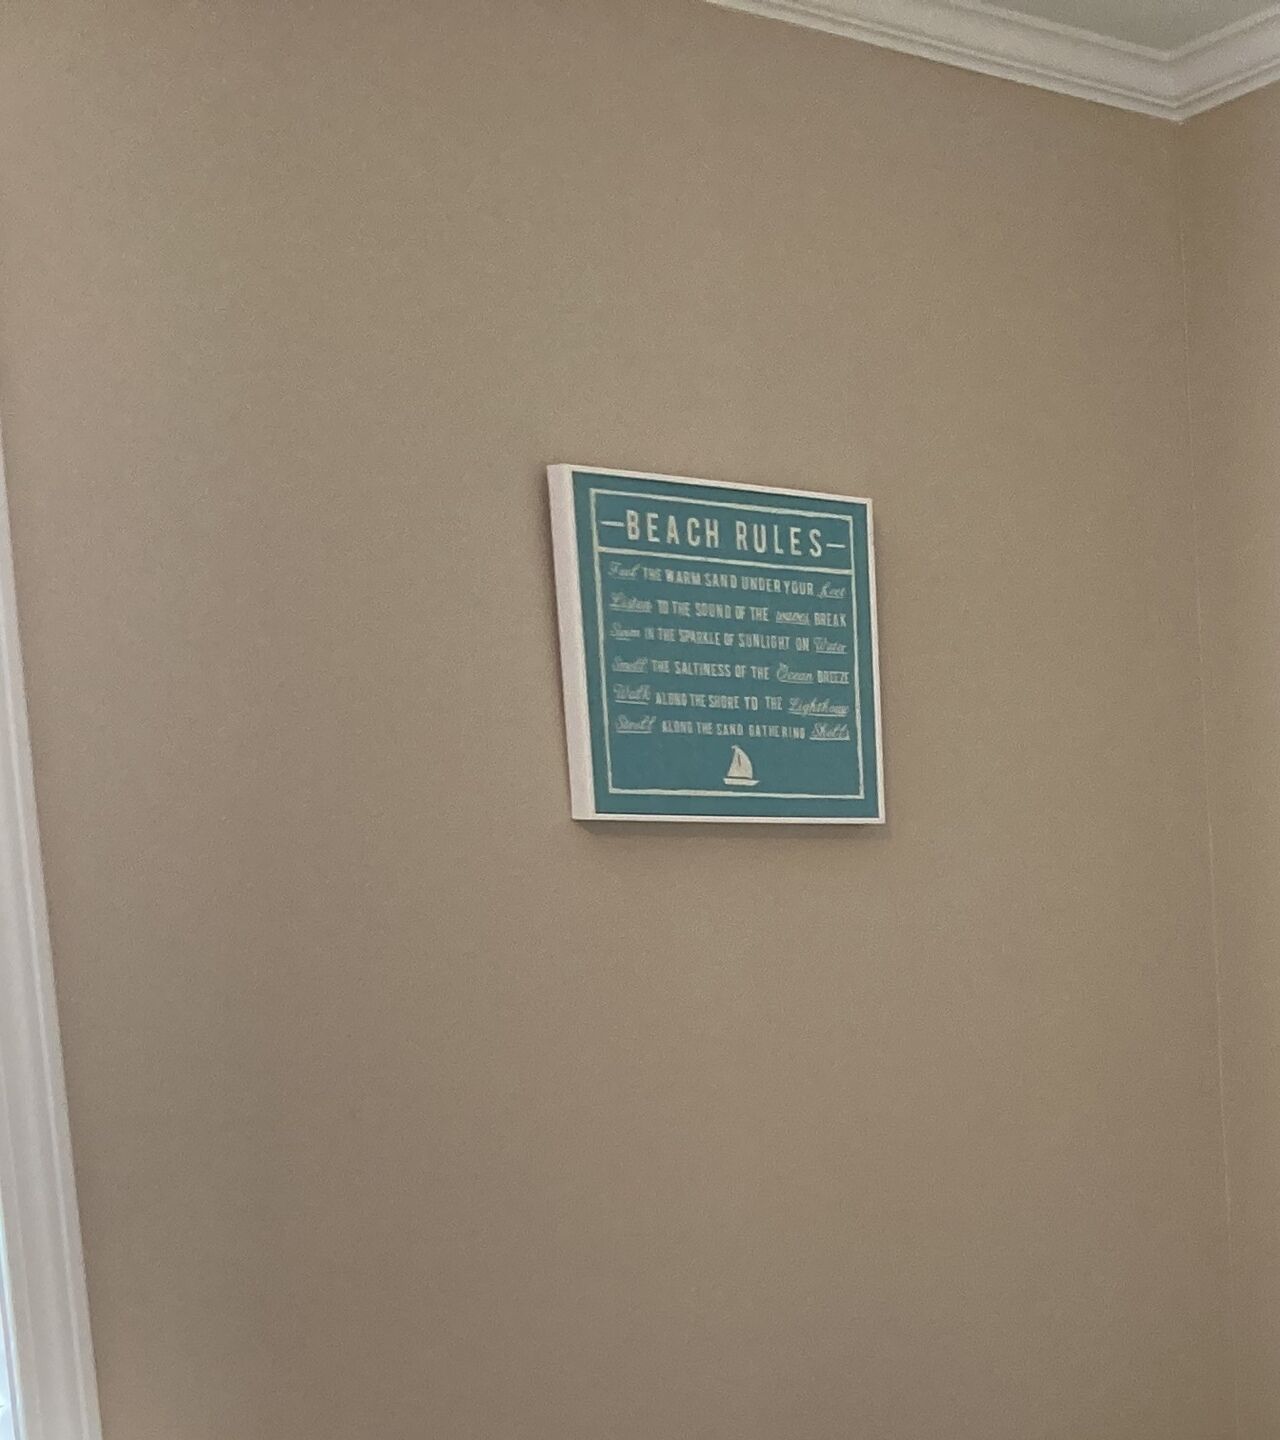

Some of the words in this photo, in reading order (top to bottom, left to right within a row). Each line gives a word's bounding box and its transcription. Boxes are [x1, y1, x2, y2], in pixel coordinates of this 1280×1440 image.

[626, 510, 718, 548] BEACH
[736, 521, 822, 557] RULES
[643, 568, 662, 581] THE
[665, 569, 701, 585] WARM
[705, 573, 737, 588] SAND
[742, 577, 781, 594] UNDER
[783, 581, 814, 596] YOUR
[657, 600, 669, 614] TO
[672, 601, 691, 617] THE
[695, 603, 731, 619] SOUND
[735, 606, 746, 619] OF
[750, 607, 769, 621] THE
[814, 612, 846, 627] BREAK
[645, 628, 655, 640] IN
[659, 628, 675, 641] THE
[679, 629, 721, 646] SPARKLE
[724, 633, 734, 646] OF
[739, 634, 790, 650] SUNLIGHT
[795, 638, 810, 651] ON
[652, 660, 670, 673] THE
[675, 662, 731, 677] SALTINESS
[735, 665, 746, 678] OF
[751, 666, 770, 680] THE
[817, 670, 849, 683] BREEZE
[656, 693, 687, 705] ALONG
[690, 694, 706, 707] THE
[709, 695, 740, 709] SHORE
[745, 697, 758, 710] TO
[765, 696, 783, 710] THE
[662, 720, 693, 733] ALONG
[697, 722, 713, 734] THE
[717, 723, 744, 735] SAND
[749, 725, 805, 739] GATHERING
